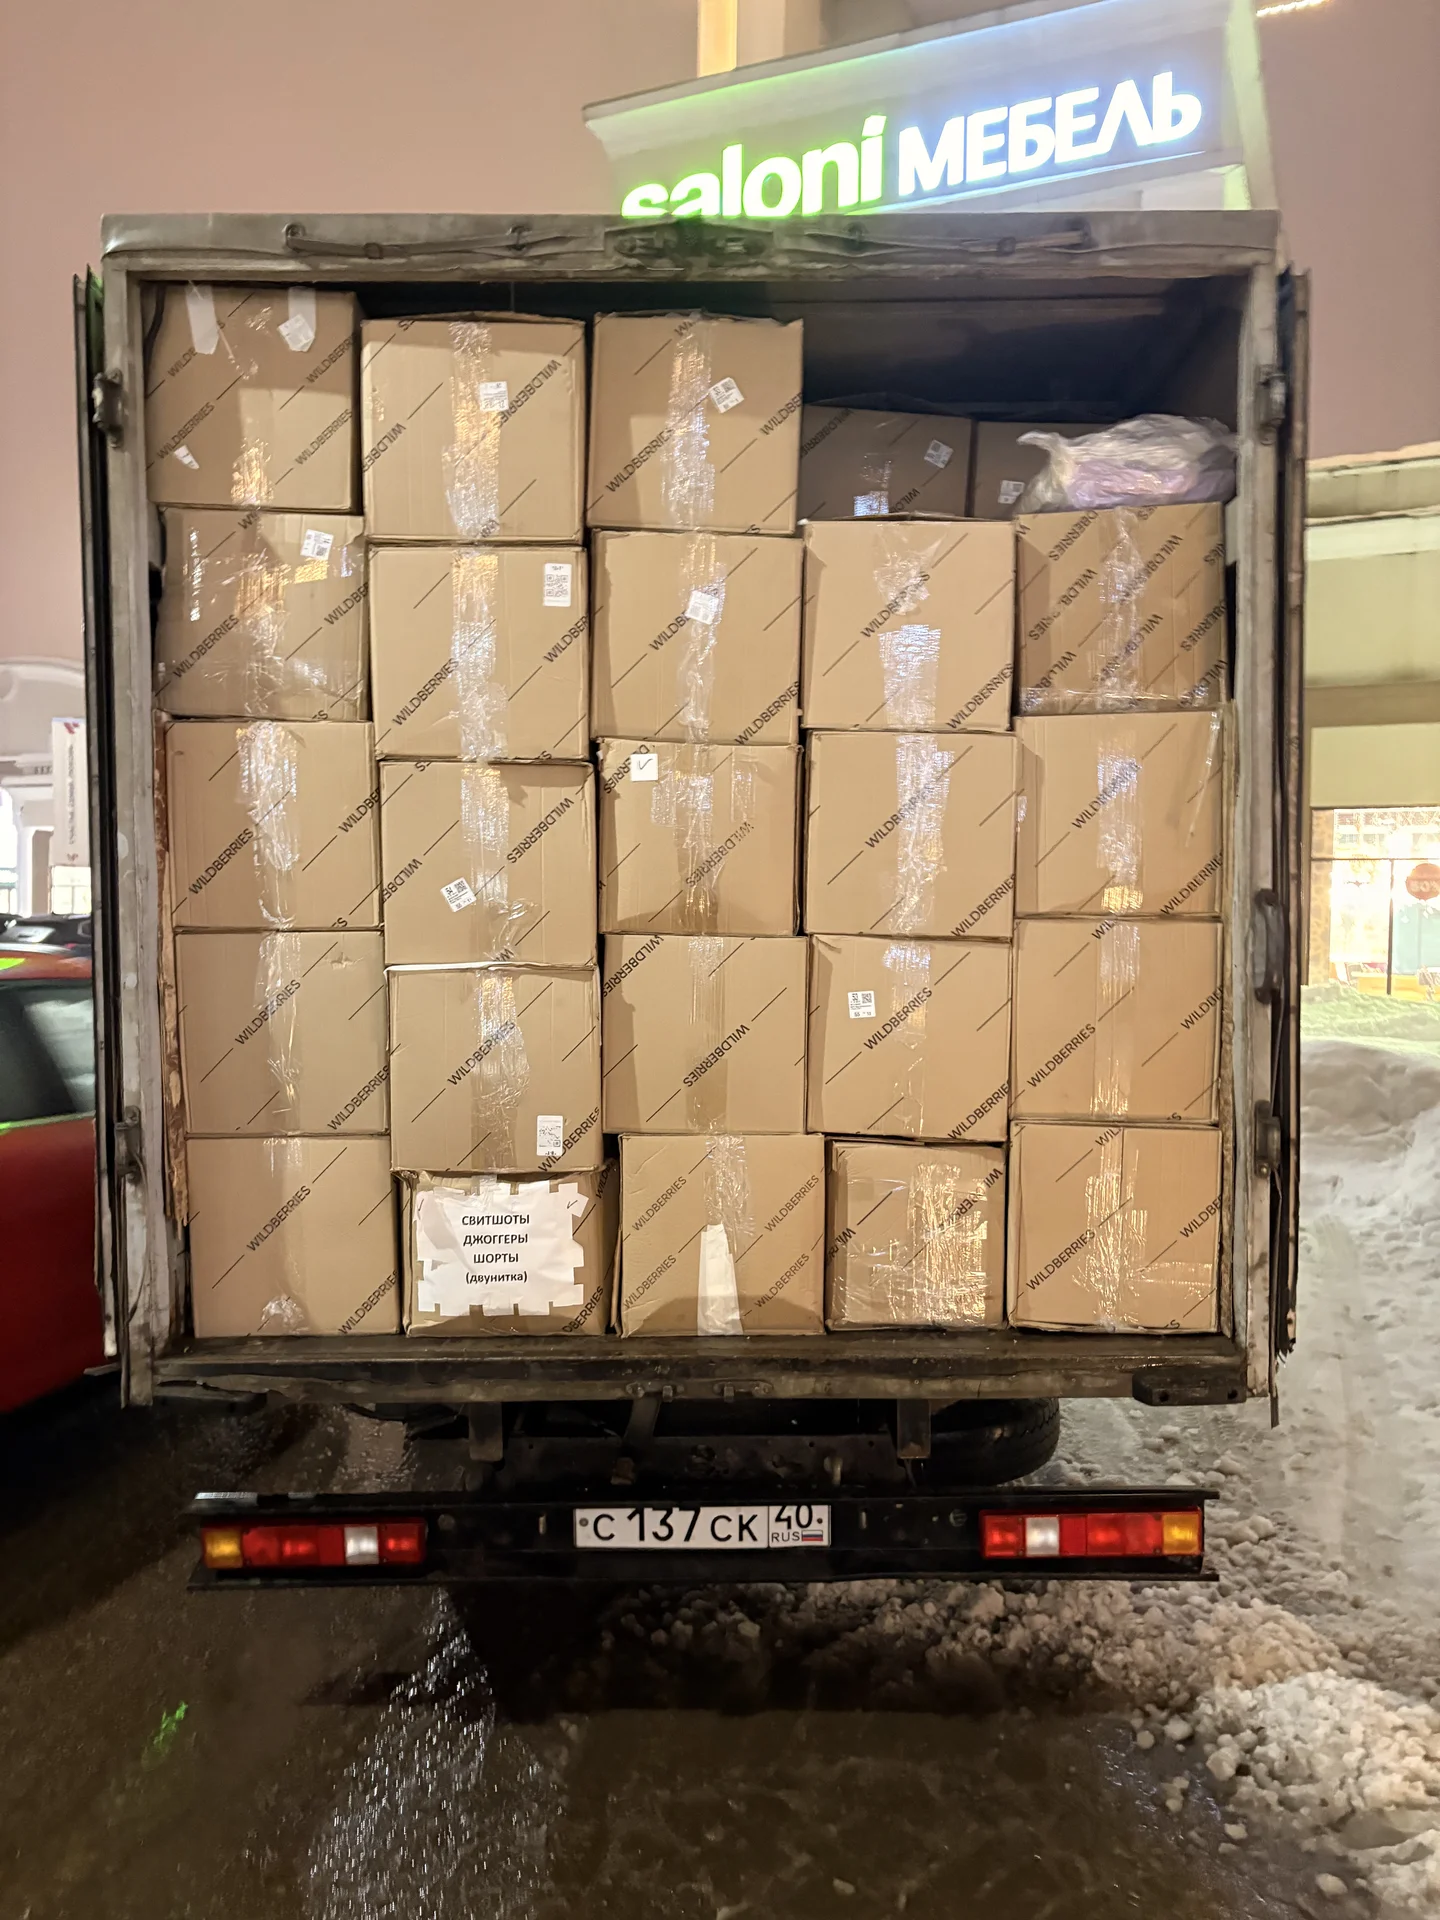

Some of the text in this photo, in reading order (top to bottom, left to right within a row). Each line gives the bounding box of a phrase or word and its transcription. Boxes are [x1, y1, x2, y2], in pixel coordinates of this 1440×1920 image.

[898, 71, 1203, 196] МЕБЕЛЬ
[157, 402, 216, 460] WILDBERRIES
[295, 408, 354, 466] WILDBERRIES
[173, 613, 240, 679] WILDBERRIES
[391, 656, 460, 727] WILDBERRIES
[188, 827, 255, 896] WILDBERRIES
[506, 797, 576, 865] WILDBERRIES
[685, 821, 755, 888] WILDBERRIES
[234, 979, 302, 1046] WILDBERRIES
[863, 986, 933, 1051] WILDBERRIES
[447, 1019, 516, 1087] WILDBERRIES
[683, 1024, 751, 1088] WILDBERRIES
[1026, 1023, 1097, 1089] WILDBERRIES
[246, 1184, 312, 1252] WILDBERRIES
[461, 1214, 530, 1226] СВИТШОТЫ
[632, 1176, 688, 1233] WILDBERRIES
[763, 1175, 820, 1233] WILDBERRIES
[463, 1233, 529, 1247] ДЖОГГЕРЫ
[473, 1252, 519, 1264] ШОРТЫ
[1026, 1228, 1096, 1291] WILDBERRIES
[465, 1271, 528, 1285] (двунитка)
[623, 1254, 677, 1310] WILDBERRIES
[754, 1253, 810, 1309] WILDBERRIES
[771, 1531, 800, 1543] RUS
[775, 1505, 813, 1530] 40
